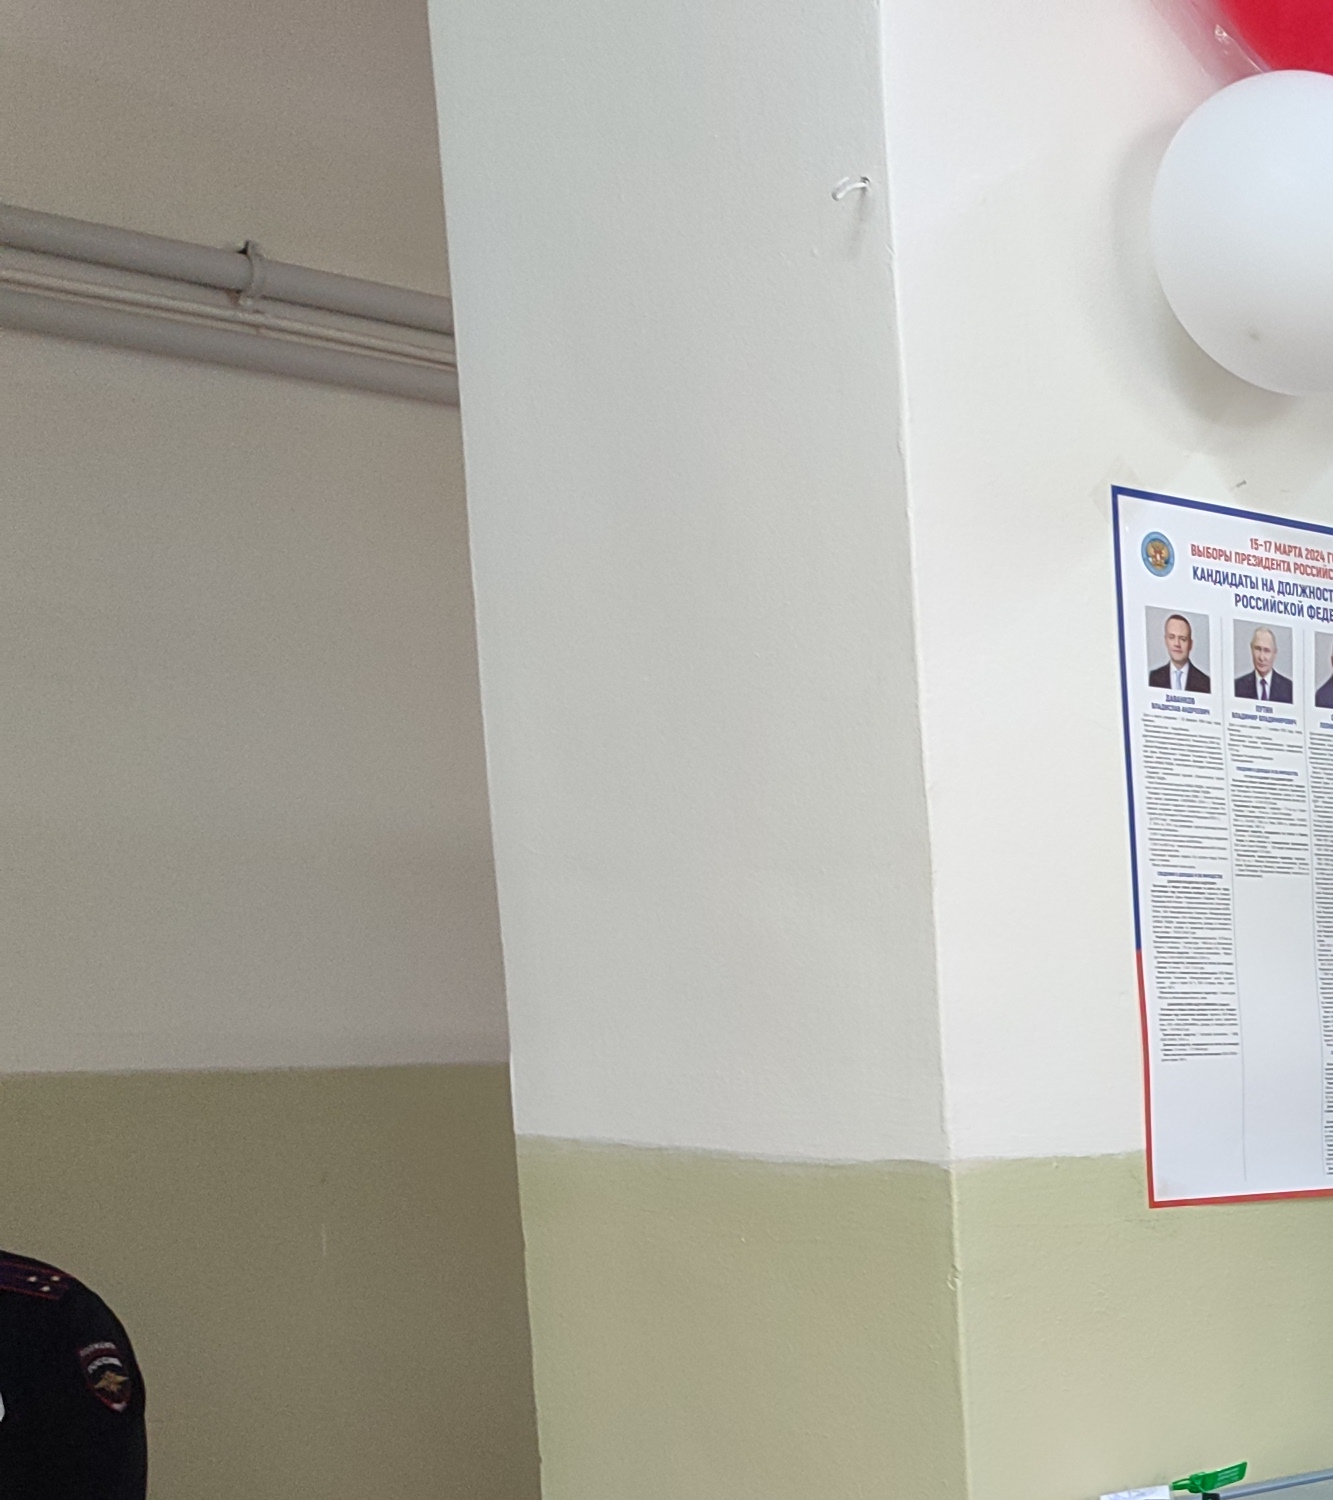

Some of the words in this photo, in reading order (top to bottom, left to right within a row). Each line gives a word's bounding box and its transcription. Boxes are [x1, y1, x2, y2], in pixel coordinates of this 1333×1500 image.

[1190, 543, 1232, 563] ВЫБОРЫ
[1234, 551, 1292, 573] ПРЕЗИДЕНТА
[1274, 543, 1303, 559] МАРТА
[1305, 548, 1325, 563] 2024
[1192, 566, 1259, 590] КАНДИДАТЫ
[1261, 577, 1275, 593] НА
[1234, 593, 1304, 618] РОССИЙСКОЙ
